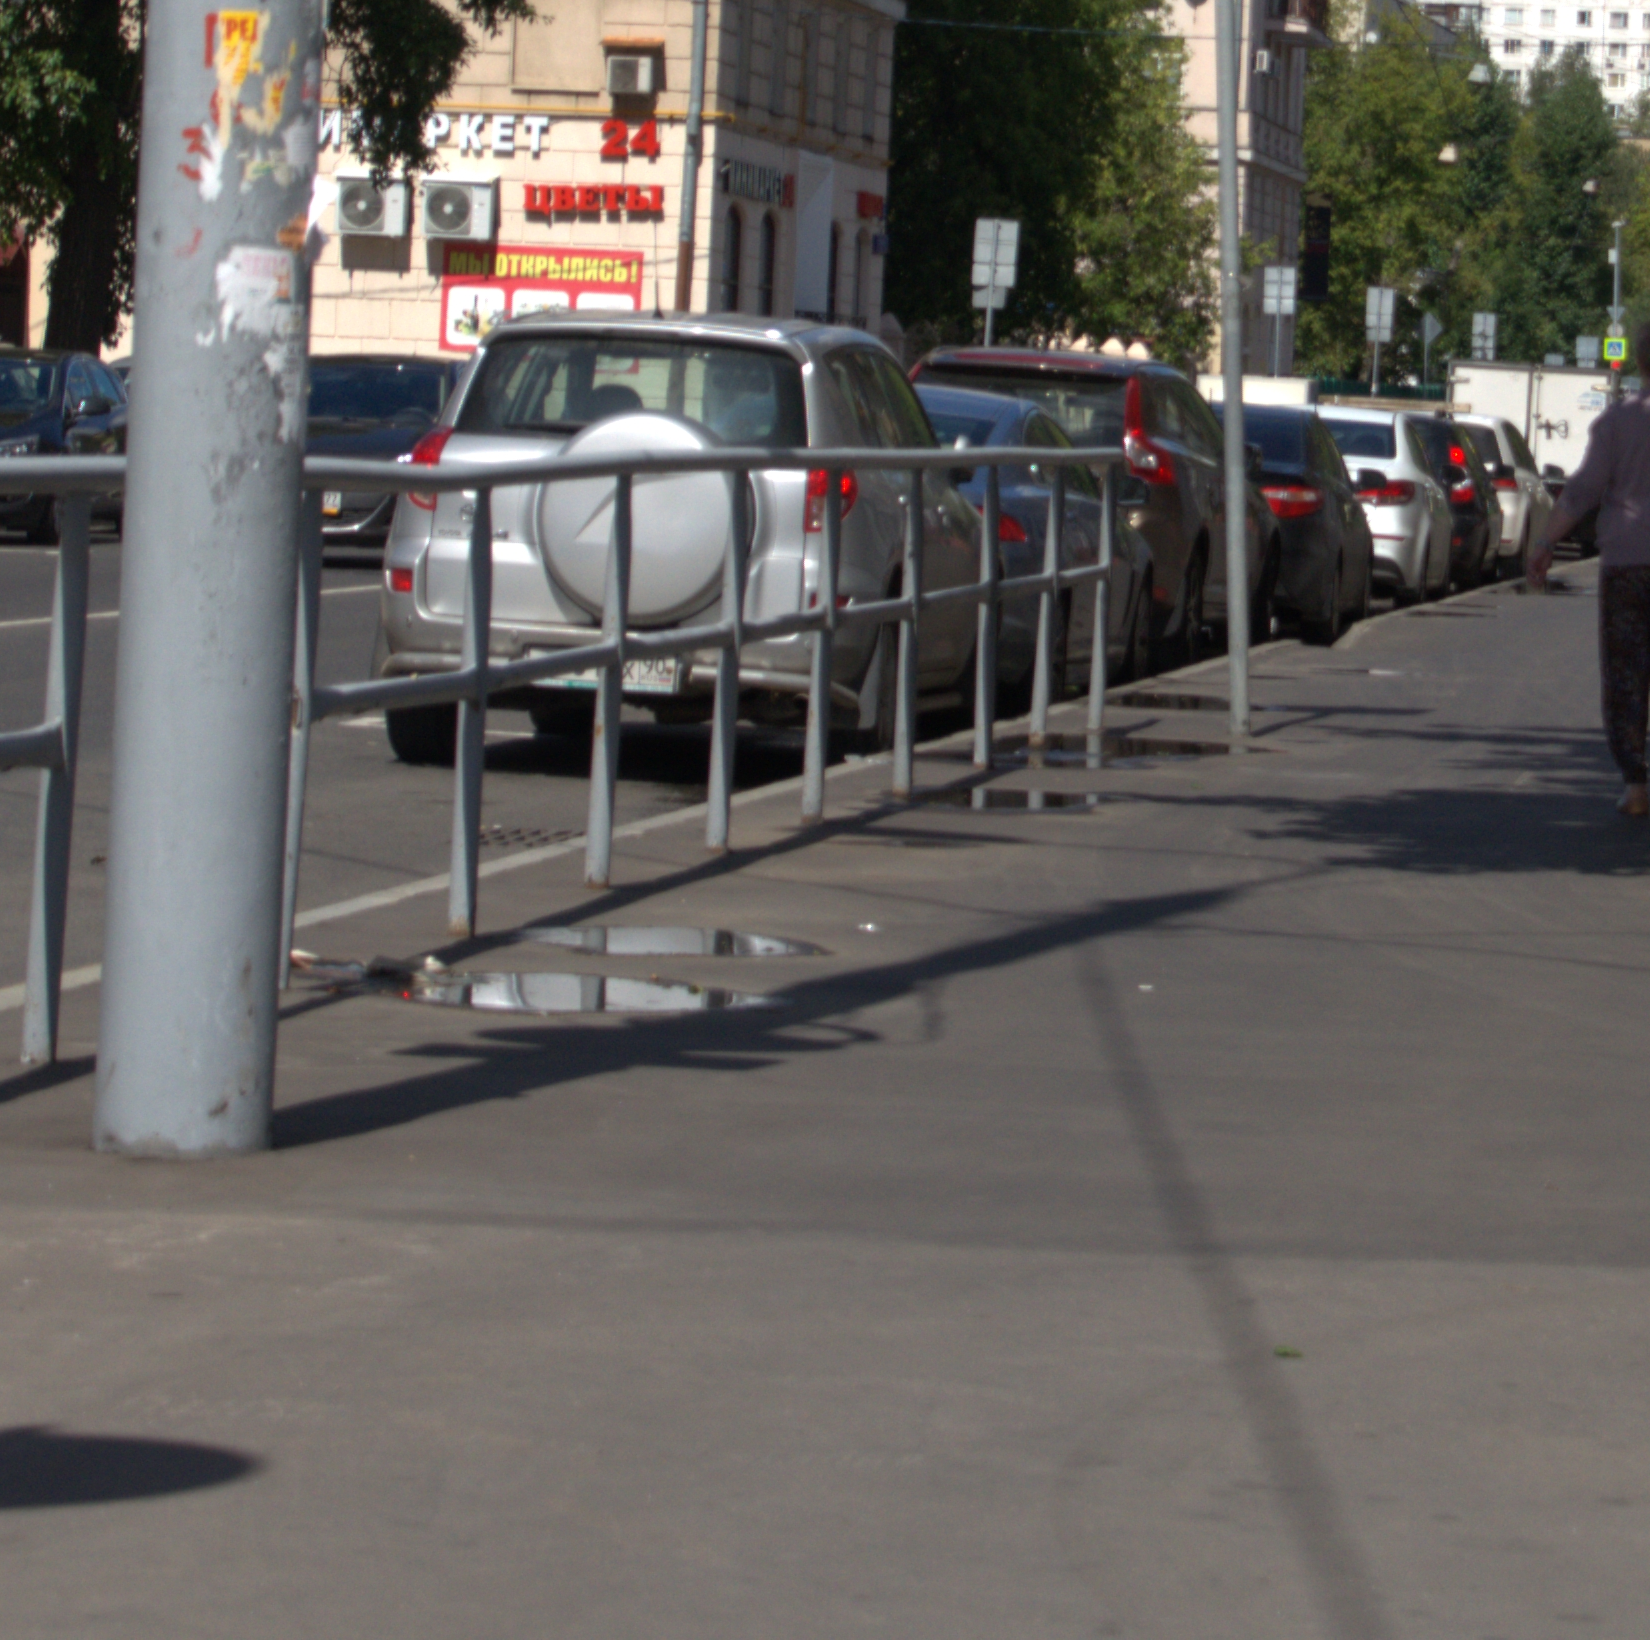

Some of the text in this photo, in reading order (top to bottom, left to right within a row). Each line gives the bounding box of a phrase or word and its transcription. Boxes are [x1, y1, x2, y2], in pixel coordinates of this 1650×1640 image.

[601, 119, 660, 157] 24
[523, 183, 664, 217] ЦВЕТЫ
[450, 252, 638, 284] МЫ ОТКРЫЛИСЬ!
